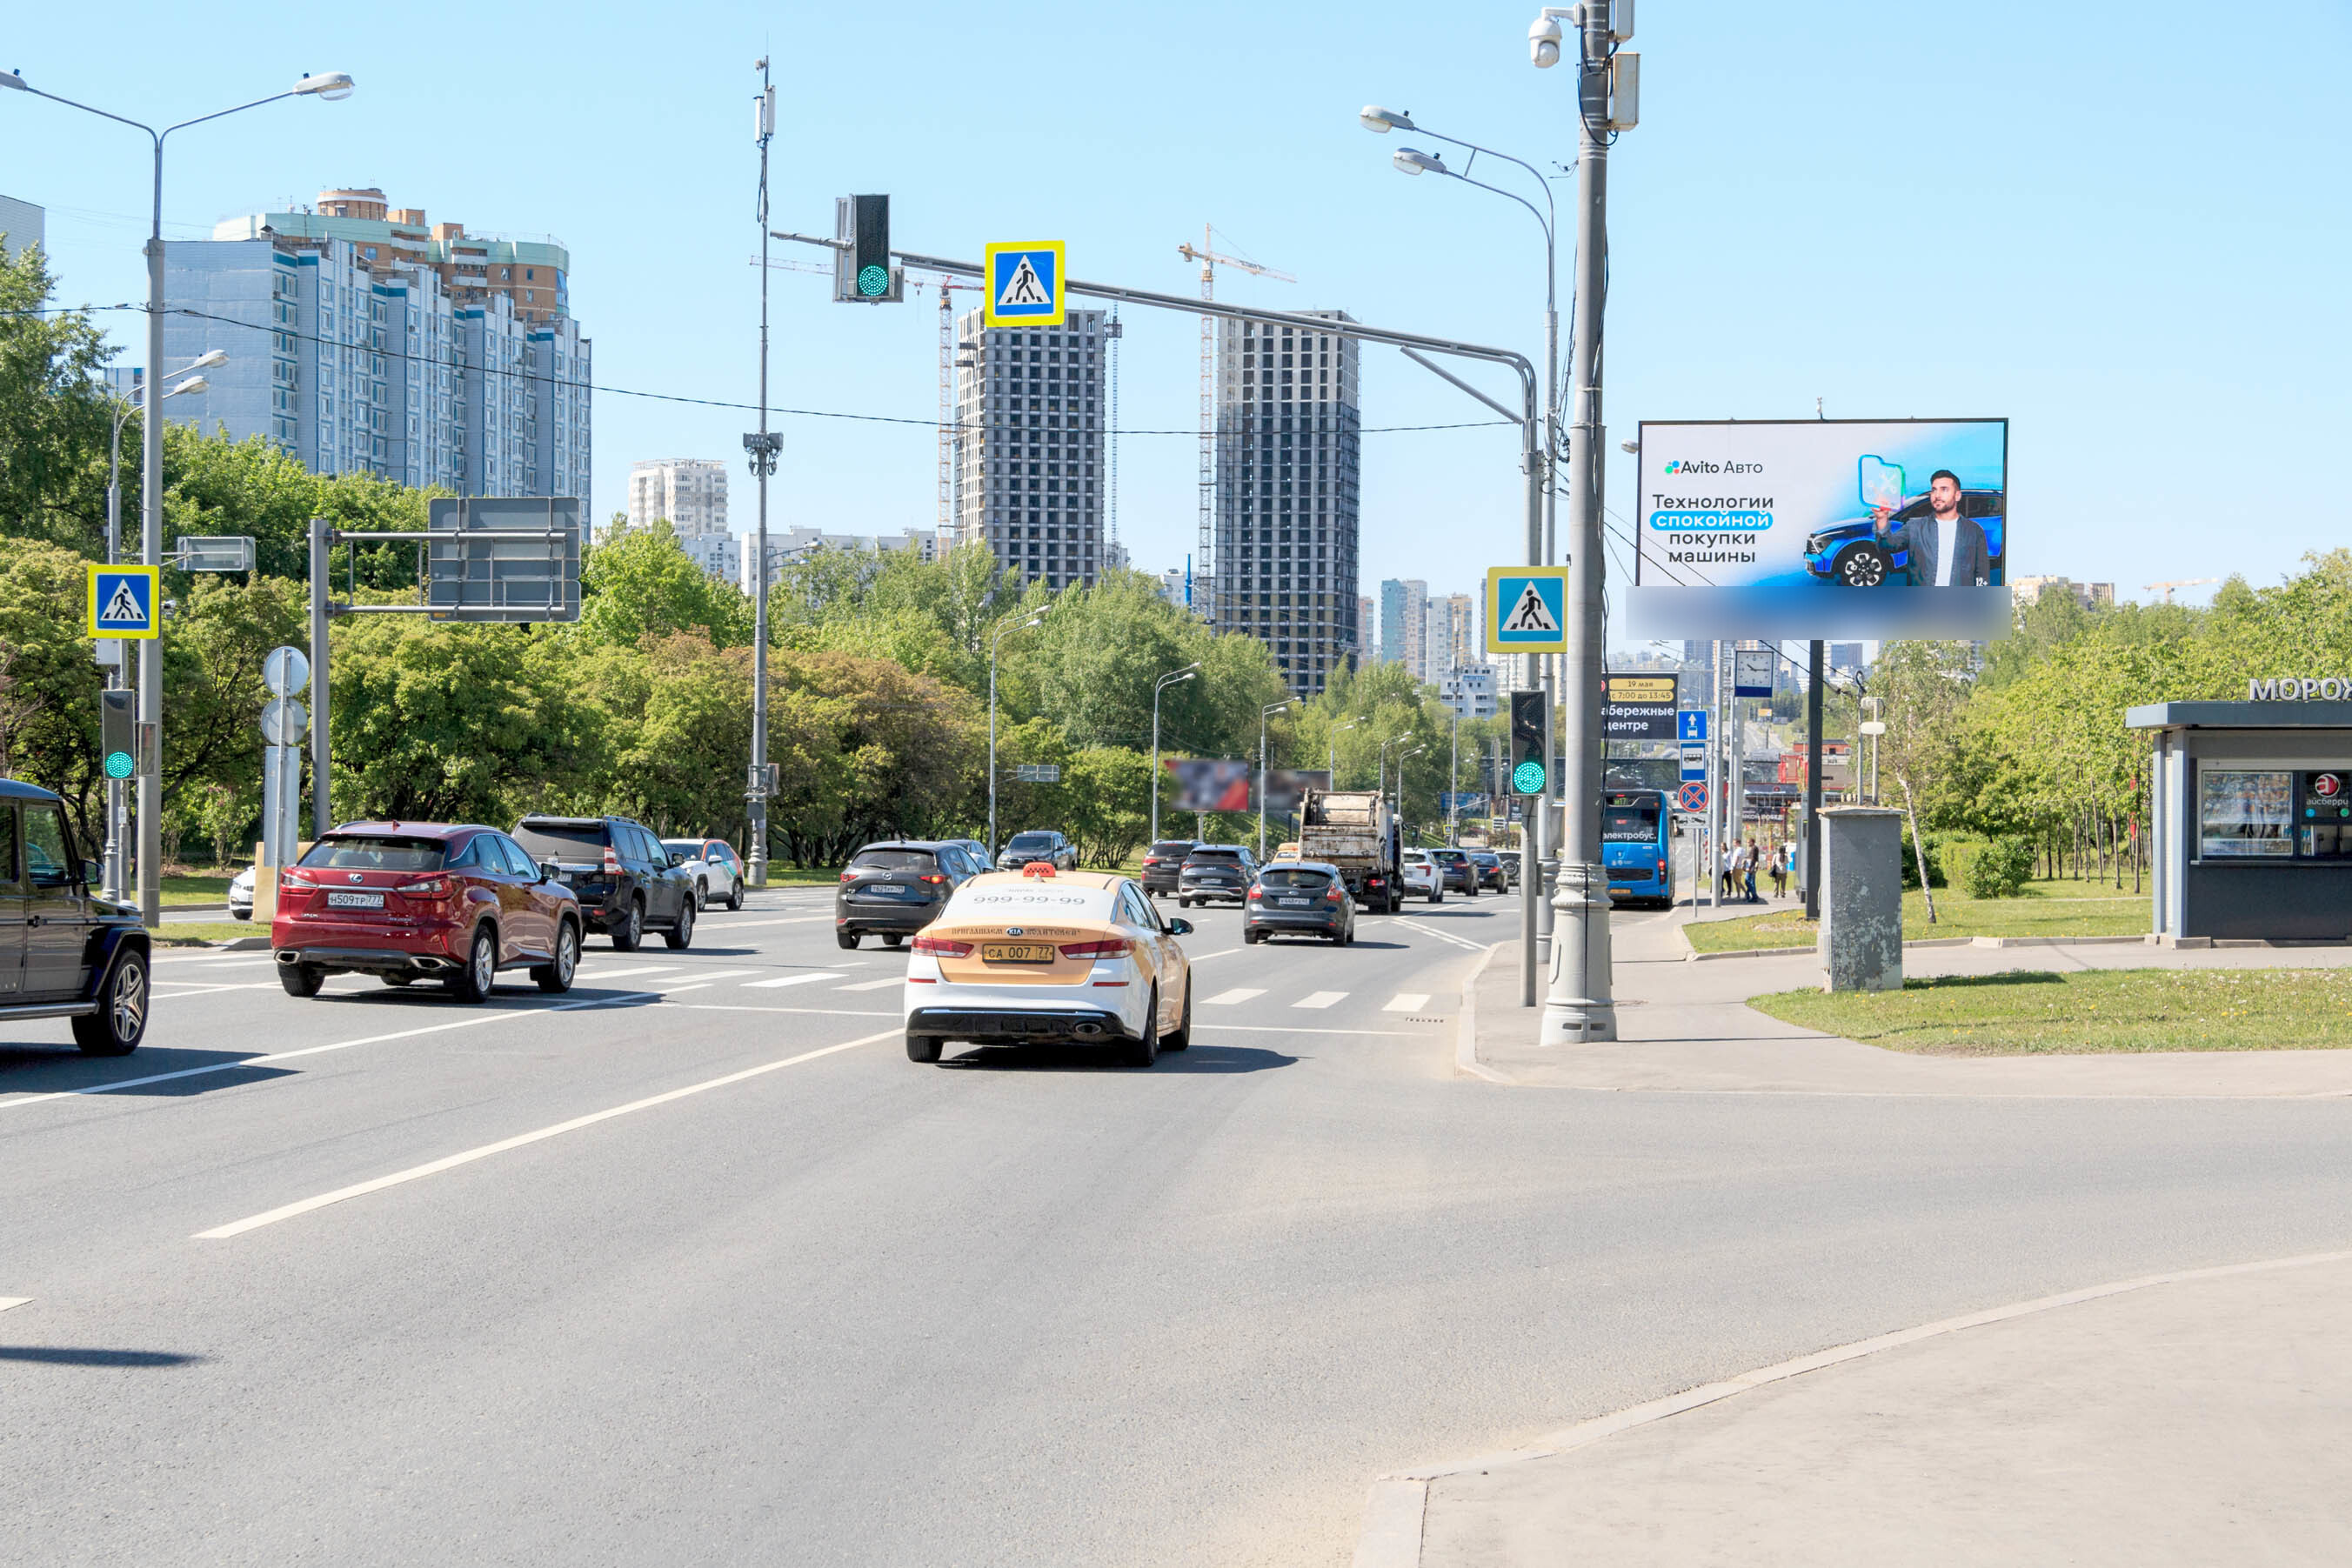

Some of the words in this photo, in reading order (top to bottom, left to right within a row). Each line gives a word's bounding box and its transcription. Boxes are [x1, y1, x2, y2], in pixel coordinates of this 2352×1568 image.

[1680, 460, 1720, 474] Avito
[1724, 460, 1763, 474] Авто
[1652, 494, 1774, 509] Технологии
[1656, 510, 1769, 527] спокойной
[1669, 533, 1755, 549] покупки
[1668, 551, 1755, 563] машины
[1975, 577, 1988, 587] 12+
[2306, 797, 2349, 807] айсберри
[331, 894, 365, 904] Н509ТР
[368, 895, 381, 904] 777
[973, 896, 1086, 905] 999-99-99
[988, 949, 1003, 958] СА
[1008, 947, 1031, 958] 007
[1038, 947, 1050, 956] 77
